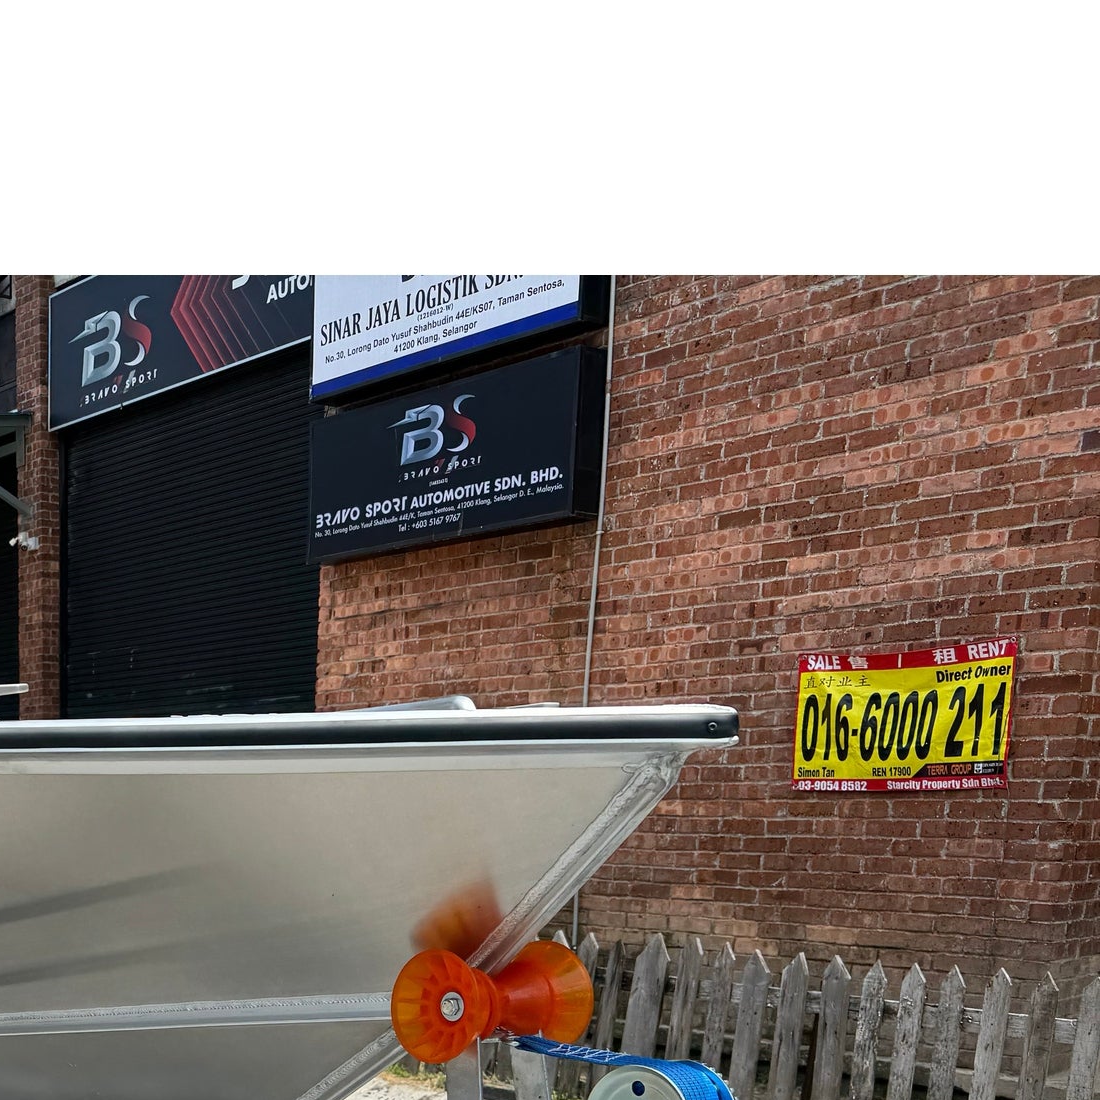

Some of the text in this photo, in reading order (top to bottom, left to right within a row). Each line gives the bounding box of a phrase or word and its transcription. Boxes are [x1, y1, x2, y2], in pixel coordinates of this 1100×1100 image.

[320, 312, 361, 346] SINAR
[366, 299, 400, 330] JAYA
[406, 275, 479, 317] LOGISTIK
[325, 280, 565, 364] No.30, Lorong Dato Yusuf Shahbudin 44E/KS07, Taman Sentosa,
[393, 320, 478, 354] 41200 Klang, Selangor
[84, 384, 118, 405] BRAVO
[403, 465, 440, 481] BRAVO
[316, 506, 360, 529] BRAVO
[365, 496, 408, 518] SPORT
[410, 481, 491, 509] AUTOMOTIVE
[494, 474, 526, 492] SDN.
[530, 466, 563, 484] BHD.
[332, 526, 348, 535] Lorong
[349, 523, 361, 531] Dato
[373, 515, 398, 527] Shahbudin
[417, 509, 433, 518] Taman
[457, 499, 474, 510] 41200
[493, 492, 518, 503] Selangor
[536, 482, 564, 494] Malaysia.
[398, 522, 407, 532] Tel
[411, 518, 428, 529] +603
[429, 516, 444, 527] 5167
[445, 512, 461, 524] 9767
[807, 655, 842, 670] SALE
[932, 647, 959, 664] 租
[966, 639, 1010, 660] RENT
[936, 665, 1011, 683] Direct Owner
[801, 682, 1007, 762] 016-6000 211
[797, 767, 912, 778] Simon Tan REN 17900
[951, 763, 972, 775] GROUP
[798, 780, 840, 791] 03-9054
[841, 781, 868, 791] 8582
[887, 779, 921, 790] Starcity
[922, 778, 961, 790] Property
[962, 778, 980, 788] Sdn
